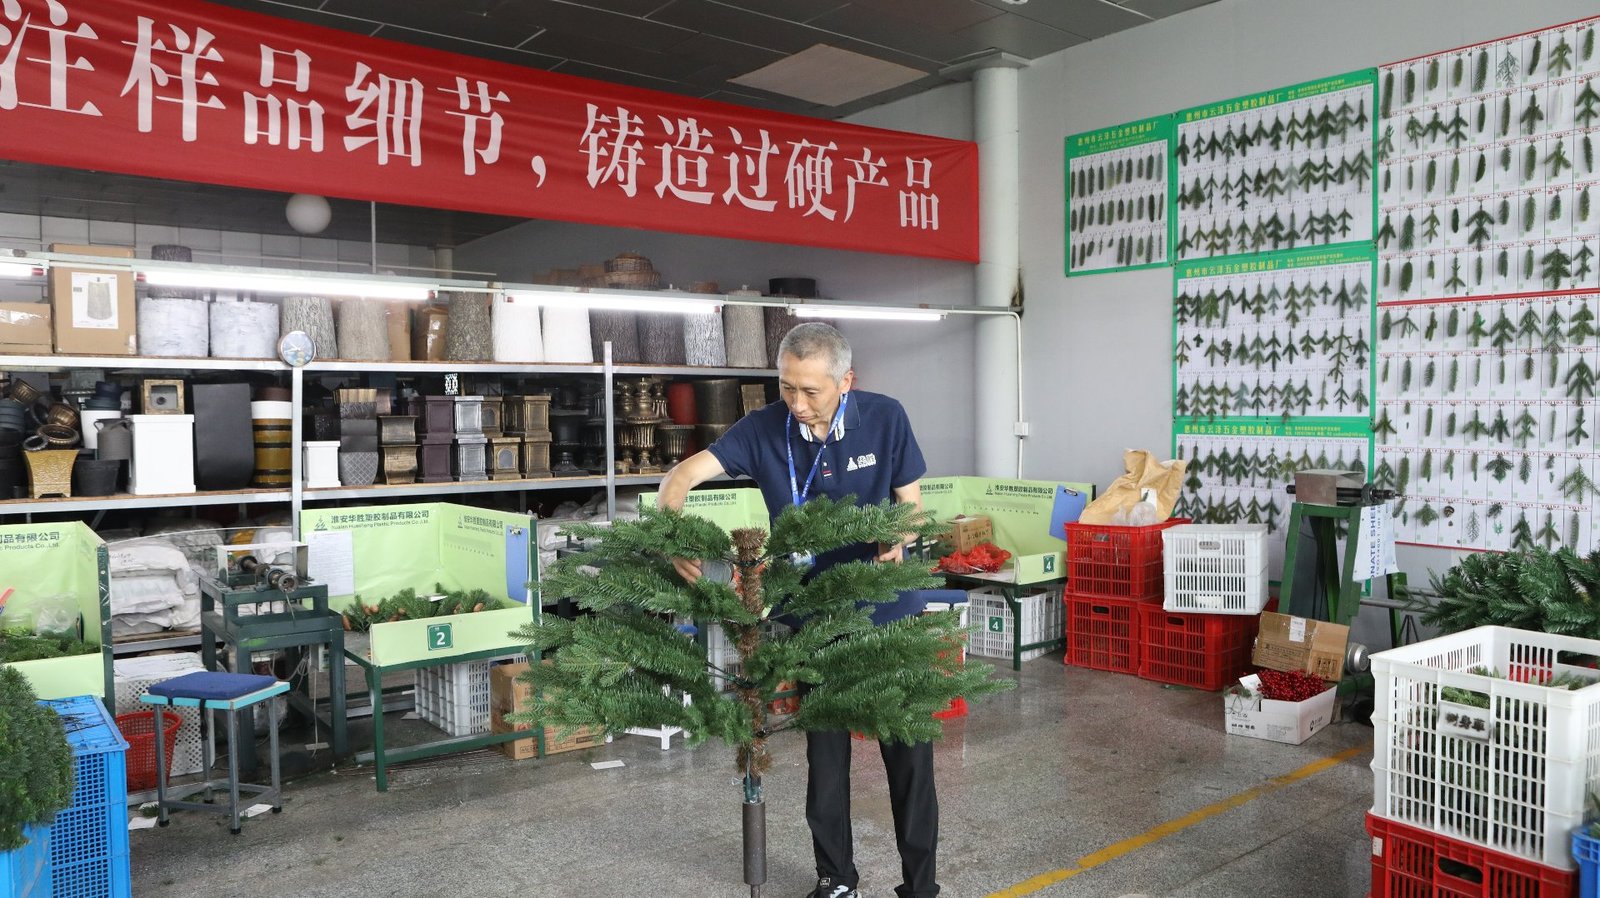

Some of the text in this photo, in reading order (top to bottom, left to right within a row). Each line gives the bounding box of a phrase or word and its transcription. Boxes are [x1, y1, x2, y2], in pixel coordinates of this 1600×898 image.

[331, 510, 430, 524] 淮安华胜塑胶制品有限公司
[1046, 561, 1051, 570] 4
[992, 621, 999, 630] 4
[436, 632, 445, 645] 2
